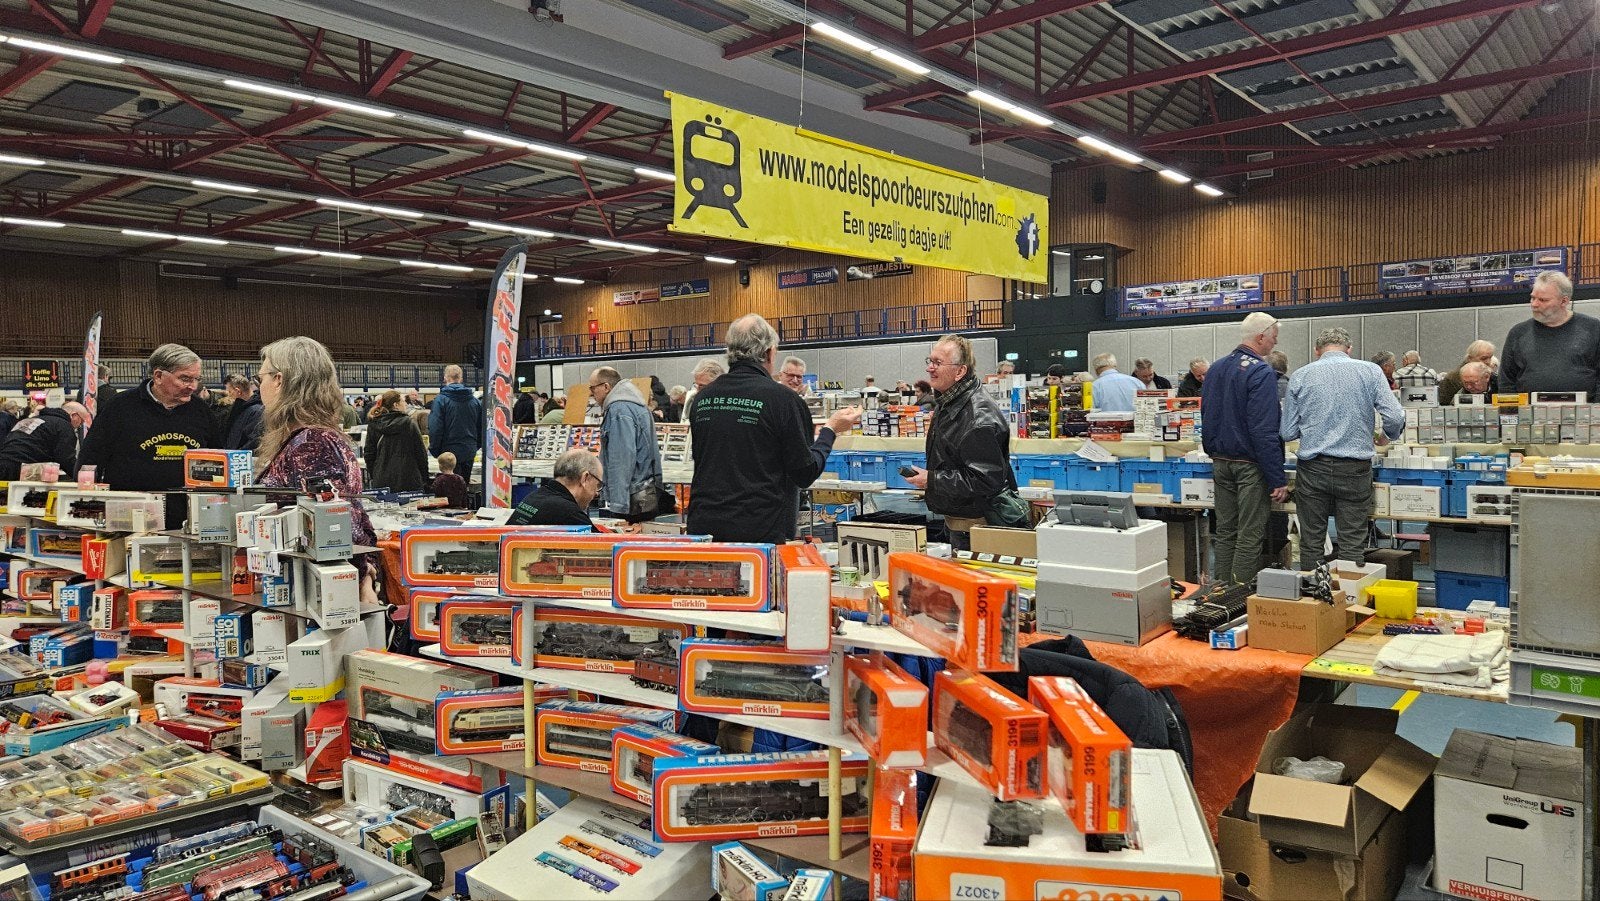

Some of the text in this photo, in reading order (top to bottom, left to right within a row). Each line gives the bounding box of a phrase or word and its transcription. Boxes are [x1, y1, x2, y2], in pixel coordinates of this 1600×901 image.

[843, 210, 952, 253] Een gezellig dagje uit!
[727, 398, 763, 408] SCHEUR
[140, 432, 201, 450] PROMOSPOOR
[475, 578, 499, 586] märkli
[264, 576, 275, 605] märk
[673, 599, 706, 608] märklin
[977, 586, 988, 618] 3010
[225, 620, 233, 636] HO
[480, 647, 508, 655] märklin
[977, 618, 987, 669] primex
[586, 662, 613, 671] märklin
[744, 704, 779, 714] märklin
[1008, 719, 1018, 747] 3196
[503, 741, 526, 750] märkl
[581, 763, 608, 772] märklin
[1084, 746, 1096, 776] 3199
[1007, 749, 1016, 796] primex
[1085, 781, 1095, 832] primex
[1503, 795, 1538, 808] UniGroup
[760, 825, 797, 836] märklin
[723, 850, 754, 875] märklin
[872, 842, 884, 870] 3192
[955, 886, 1000, 900] 43027
